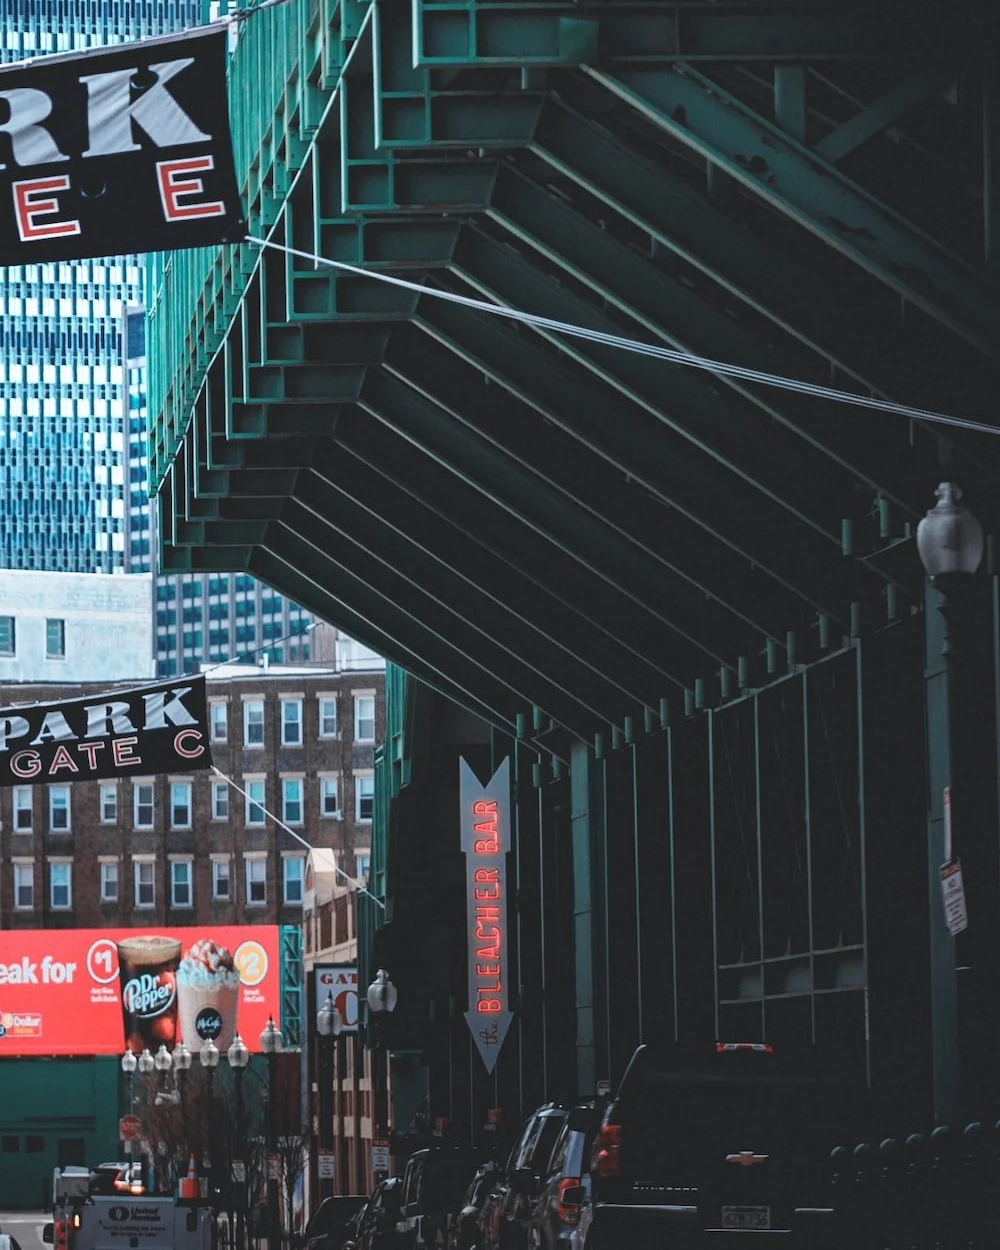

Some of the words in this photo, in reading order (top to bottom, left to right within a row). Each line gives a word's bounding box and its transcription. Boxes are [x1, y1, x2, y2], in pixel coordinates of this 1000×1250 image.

[155, 154, 227, 224] E
[10, 736, 142, 778] GATE
[173, 728, 206, 759] C
[473, 800, 499, 854] BAR
[474, 868, 502, 1015] BLEACHER
[41, 955, 77, 984] for
[94, 949, 112, 973] $1
[319, 973, 359, 985] GAT
[128, 978, 173, 1014] Pepper
[140, 974, 161, 991] Dr
